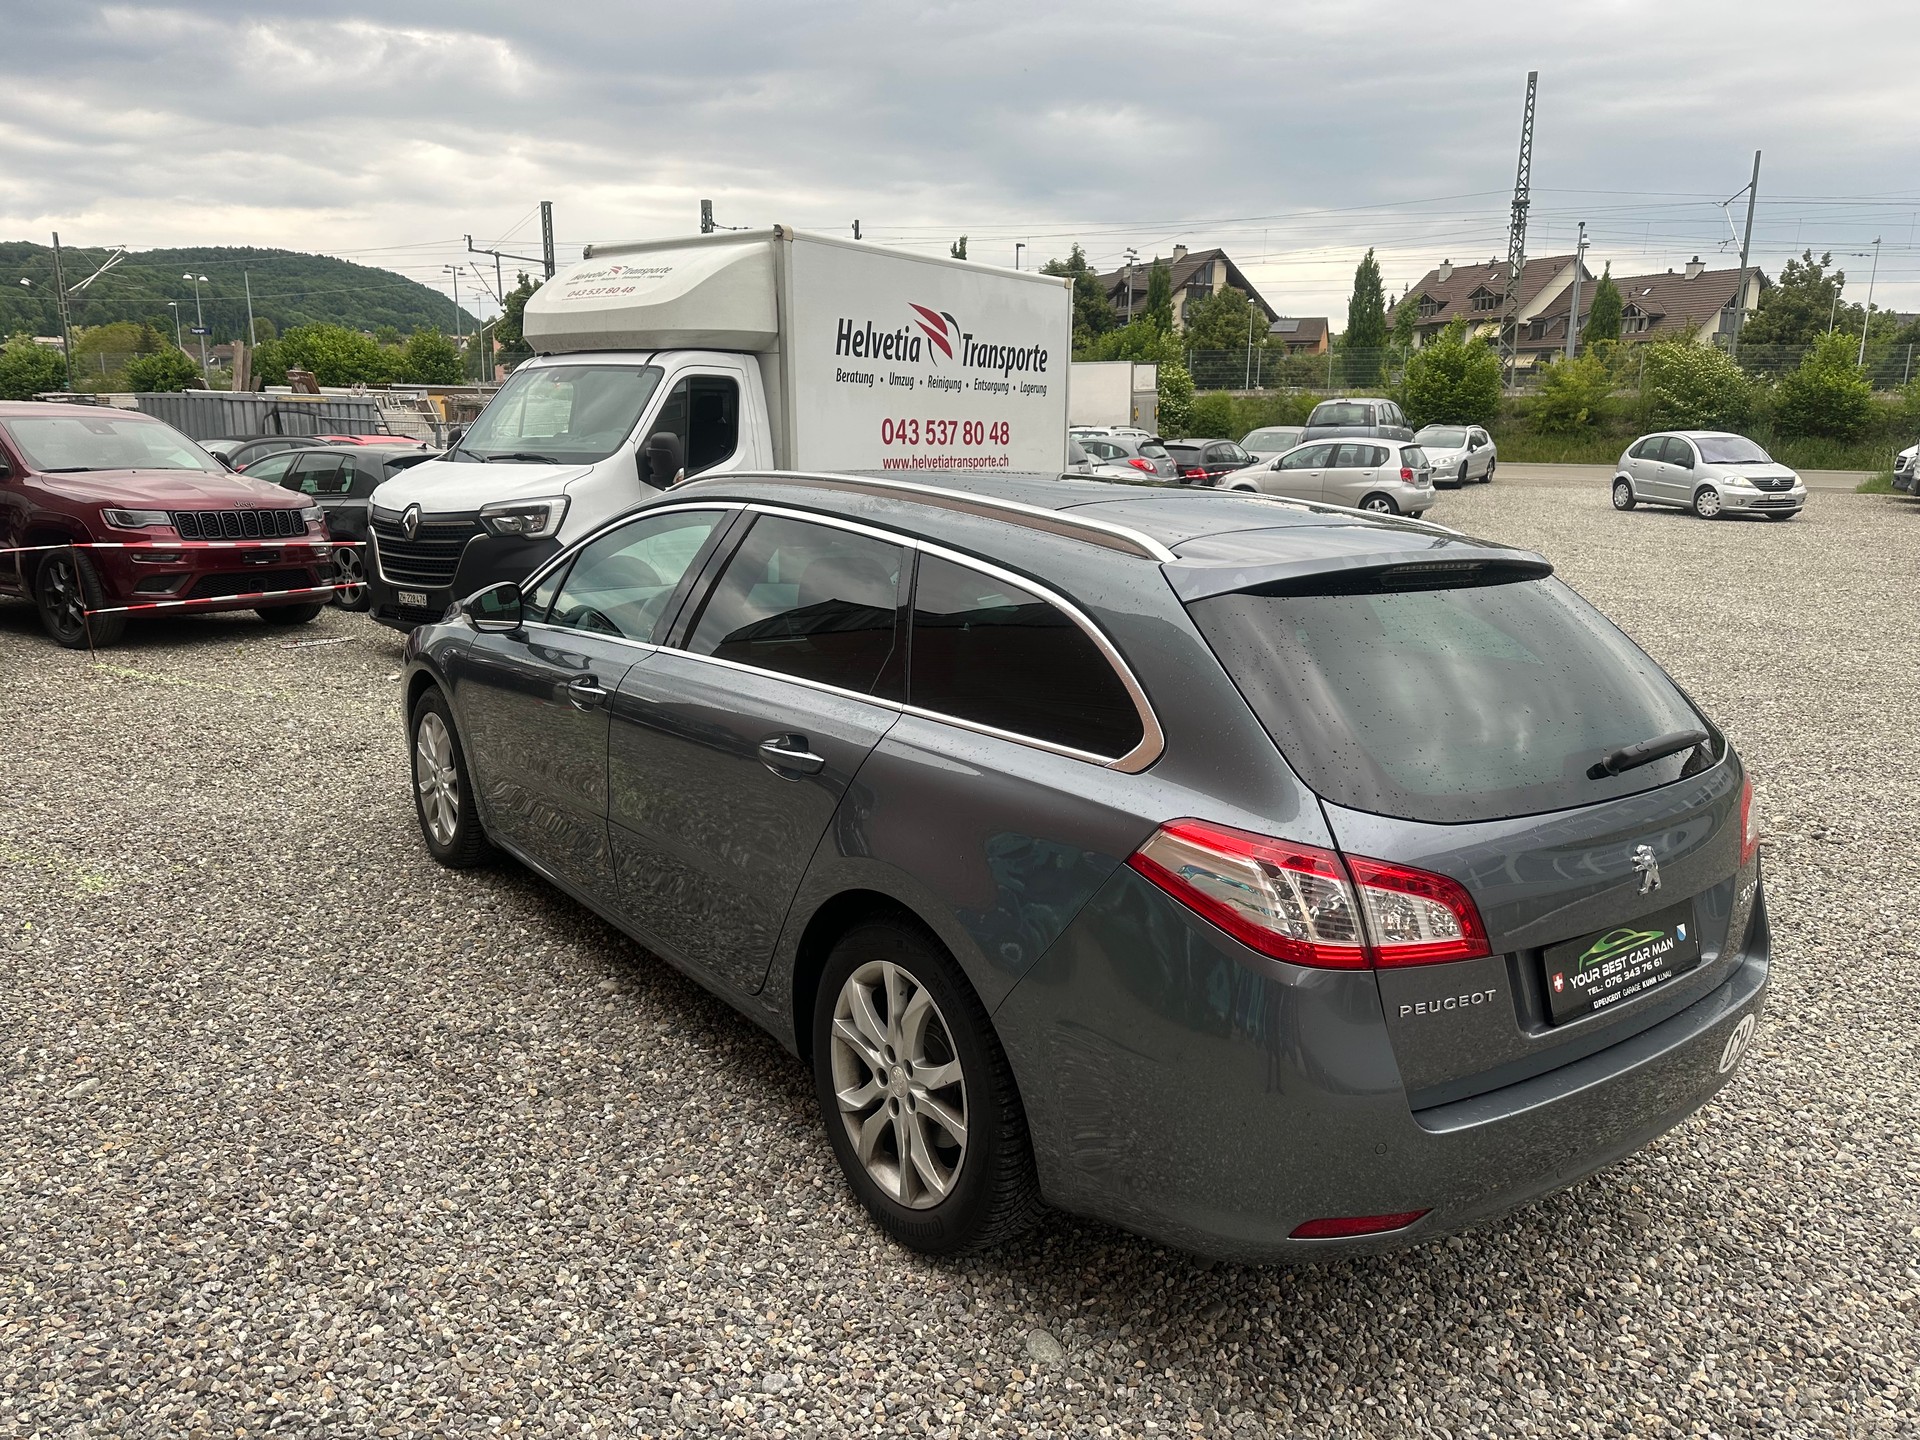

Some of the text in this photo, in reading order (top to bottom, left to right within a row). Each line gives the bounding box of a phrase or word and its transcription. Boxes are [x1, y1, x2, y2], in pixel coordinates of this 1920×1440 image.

[567, 289, 586, 298] 043
[586, 288, 606, 296] 537
[606, 286, 620, 295] 80
[621, 286, 636, 294] 48
[835, 318, 1048, 378] Helvetia Transporte
[836, 367, 1047, 397] Beratung Umzug Reinigung Entsorgung Lagerung
[881, 418, 1010, 446] 043 537 80 48
[883, 454, 1009, 470] www.helvetiatransporte.ch
[233, 500, 256, 509] Jeep
[1569, 937, 1674, 989] YOUR BEST CAR MAN
[1605, 974, 1623, 988] 076
[1624, 966, 1641, 981] 343
[1641, 963, 1653, 973] 76
[1653, 957, 1663, 967] 61
[1399, 989, 1497, 1018] PEUGEOT
[1598, 991, 1622, 1008] PEUGEOT
[1622, 982, 1642, 997] GARAGE
